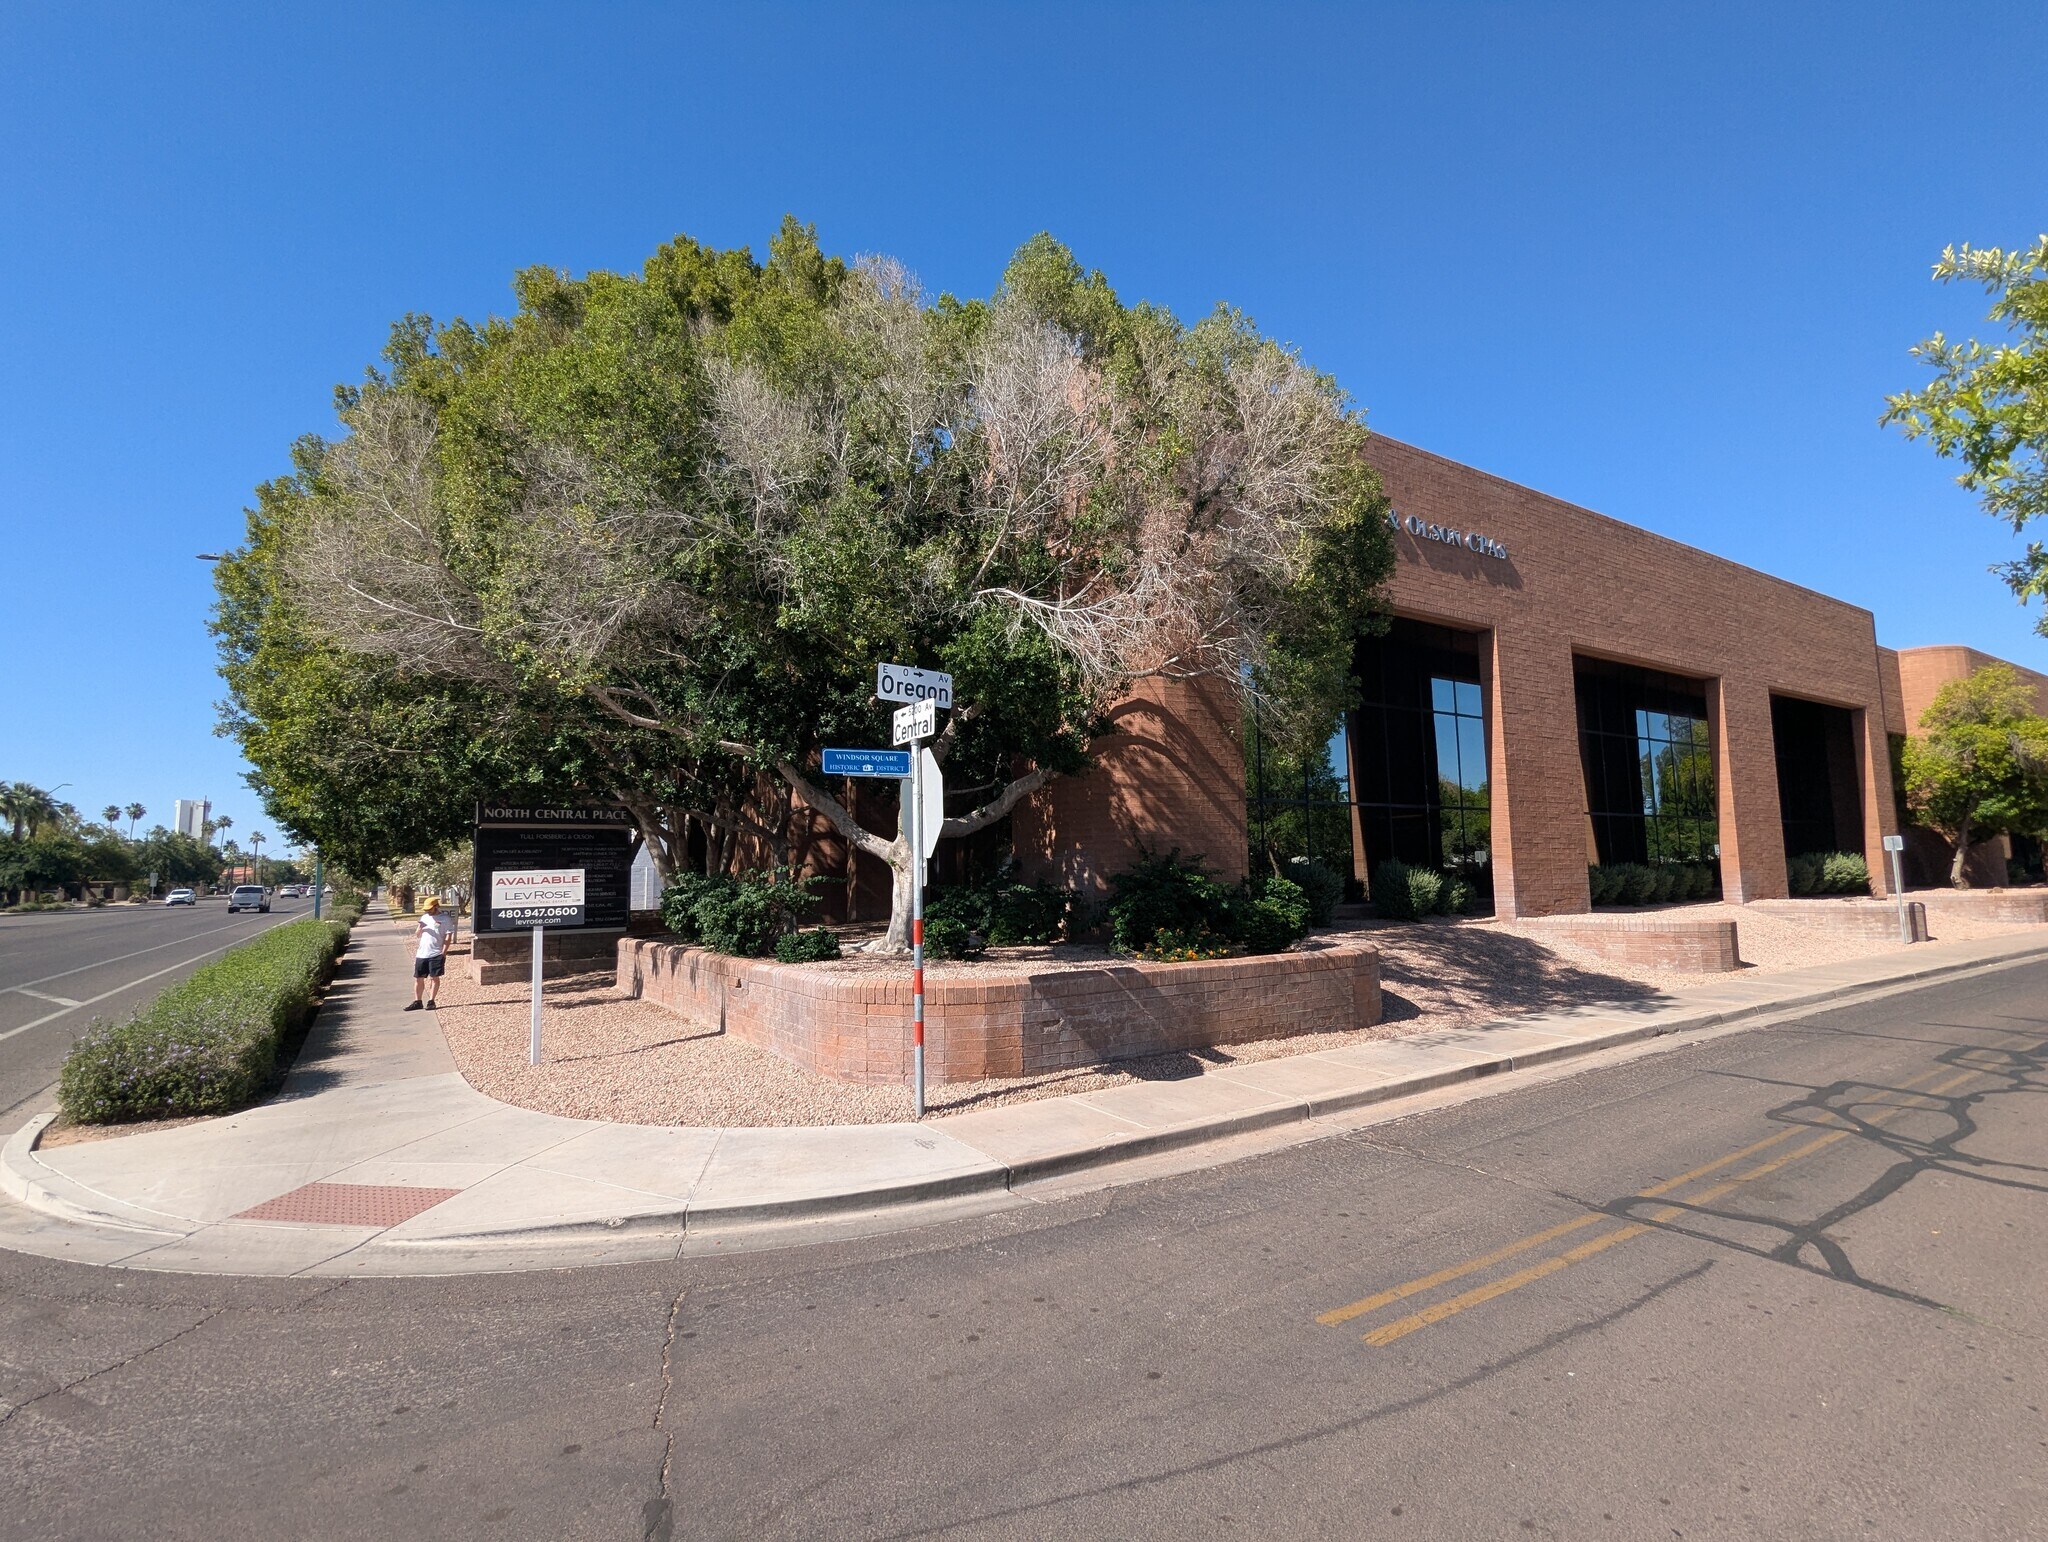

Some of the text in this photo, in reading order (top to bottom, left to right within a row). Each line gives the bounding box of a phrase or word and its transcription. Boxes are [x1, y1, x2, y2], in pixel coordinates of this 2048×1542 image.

[1386, 508, 1401, 530] &
[1405, 515, 1462, 547] OLSON
[883, 665, 889, 674] E
[938, 674, 949, 684] Av
[881, 674, 949, 703] Oregon
[925, 702, 933, 711] Av
[895, 713, 933, 742] Central
[484, 808, 628, 820] NORTH CENTRAL PLACE
[496, 876, 581, 886] AVAILABLE
[498, 907, 578, 919] 480.947.0600
[515, 917, 562, 926] levrose.com
